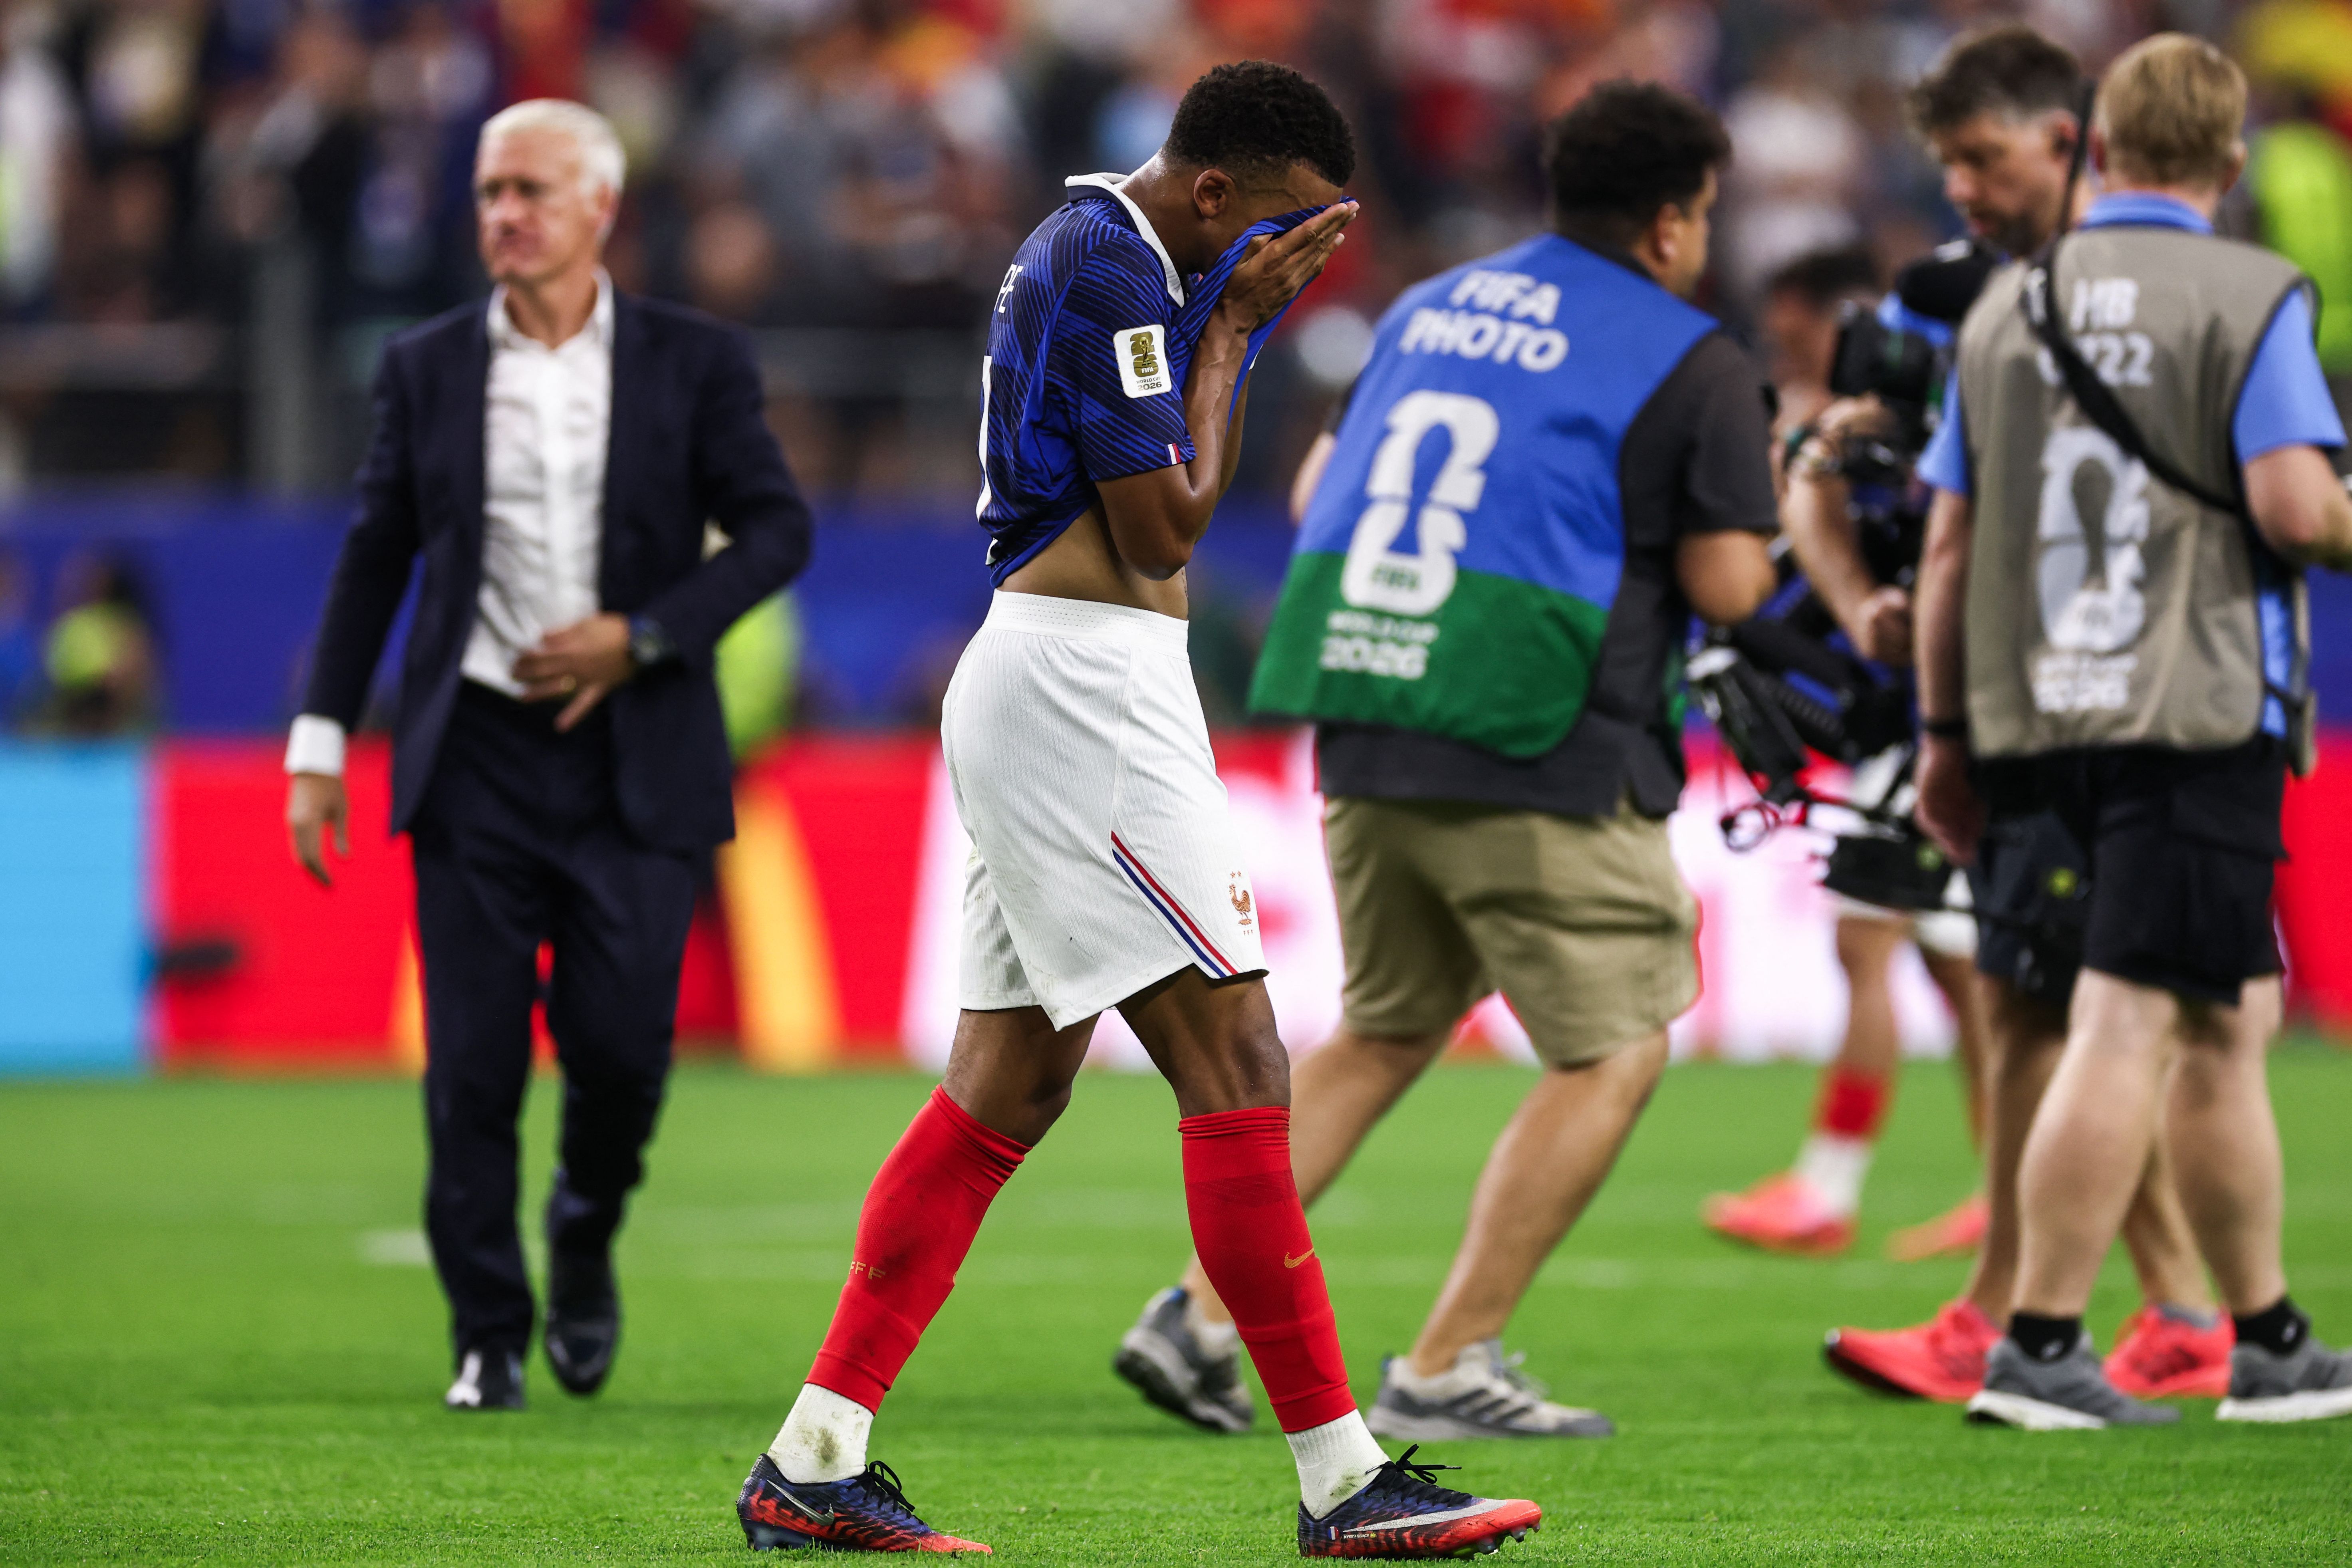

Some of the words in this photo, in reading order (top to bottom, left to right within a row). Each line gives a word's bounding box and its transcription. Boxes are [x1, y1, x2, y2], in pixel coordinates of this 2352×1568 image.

[1449, 269, 1562, 325] FIFA
[1399, 307, 1570, 373] PHOTO
[1137, 381, 1162, 391] 2026
[1318, 637, 1430, 681] 2026
